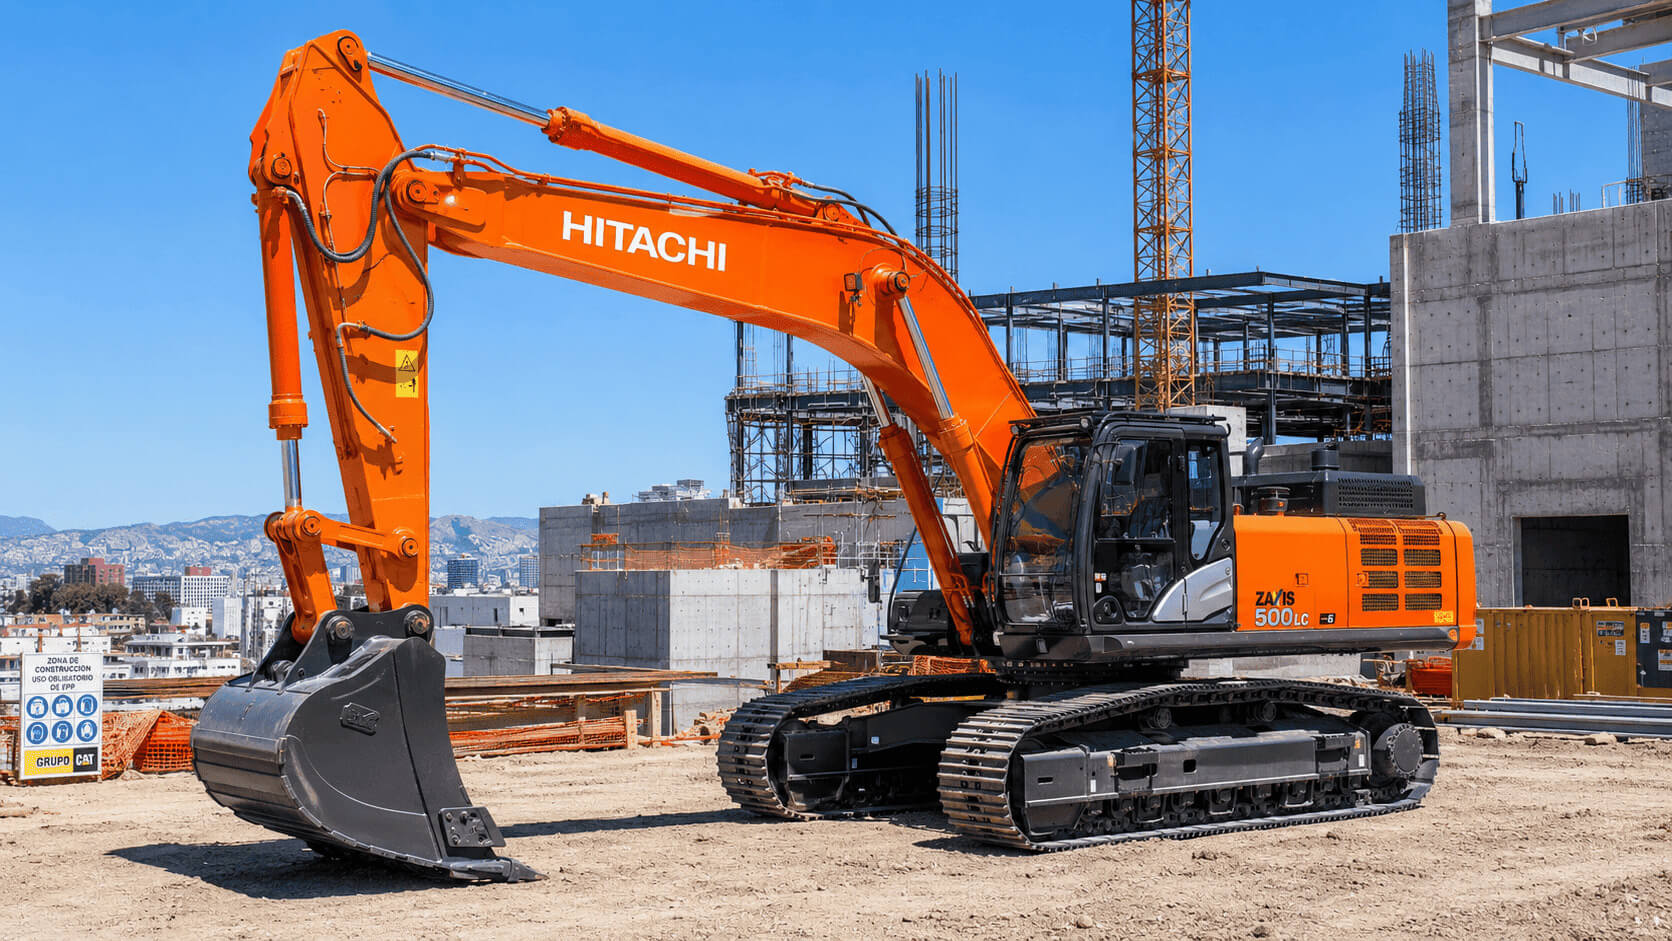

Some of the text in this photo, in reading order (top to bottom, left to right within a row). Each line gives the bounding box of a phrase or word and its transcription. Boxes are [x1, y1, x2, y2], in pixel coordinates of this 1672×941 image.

[562, 210, 726, 272] HITACHI
[36, 754, 94, 767] GRUPO CAT
